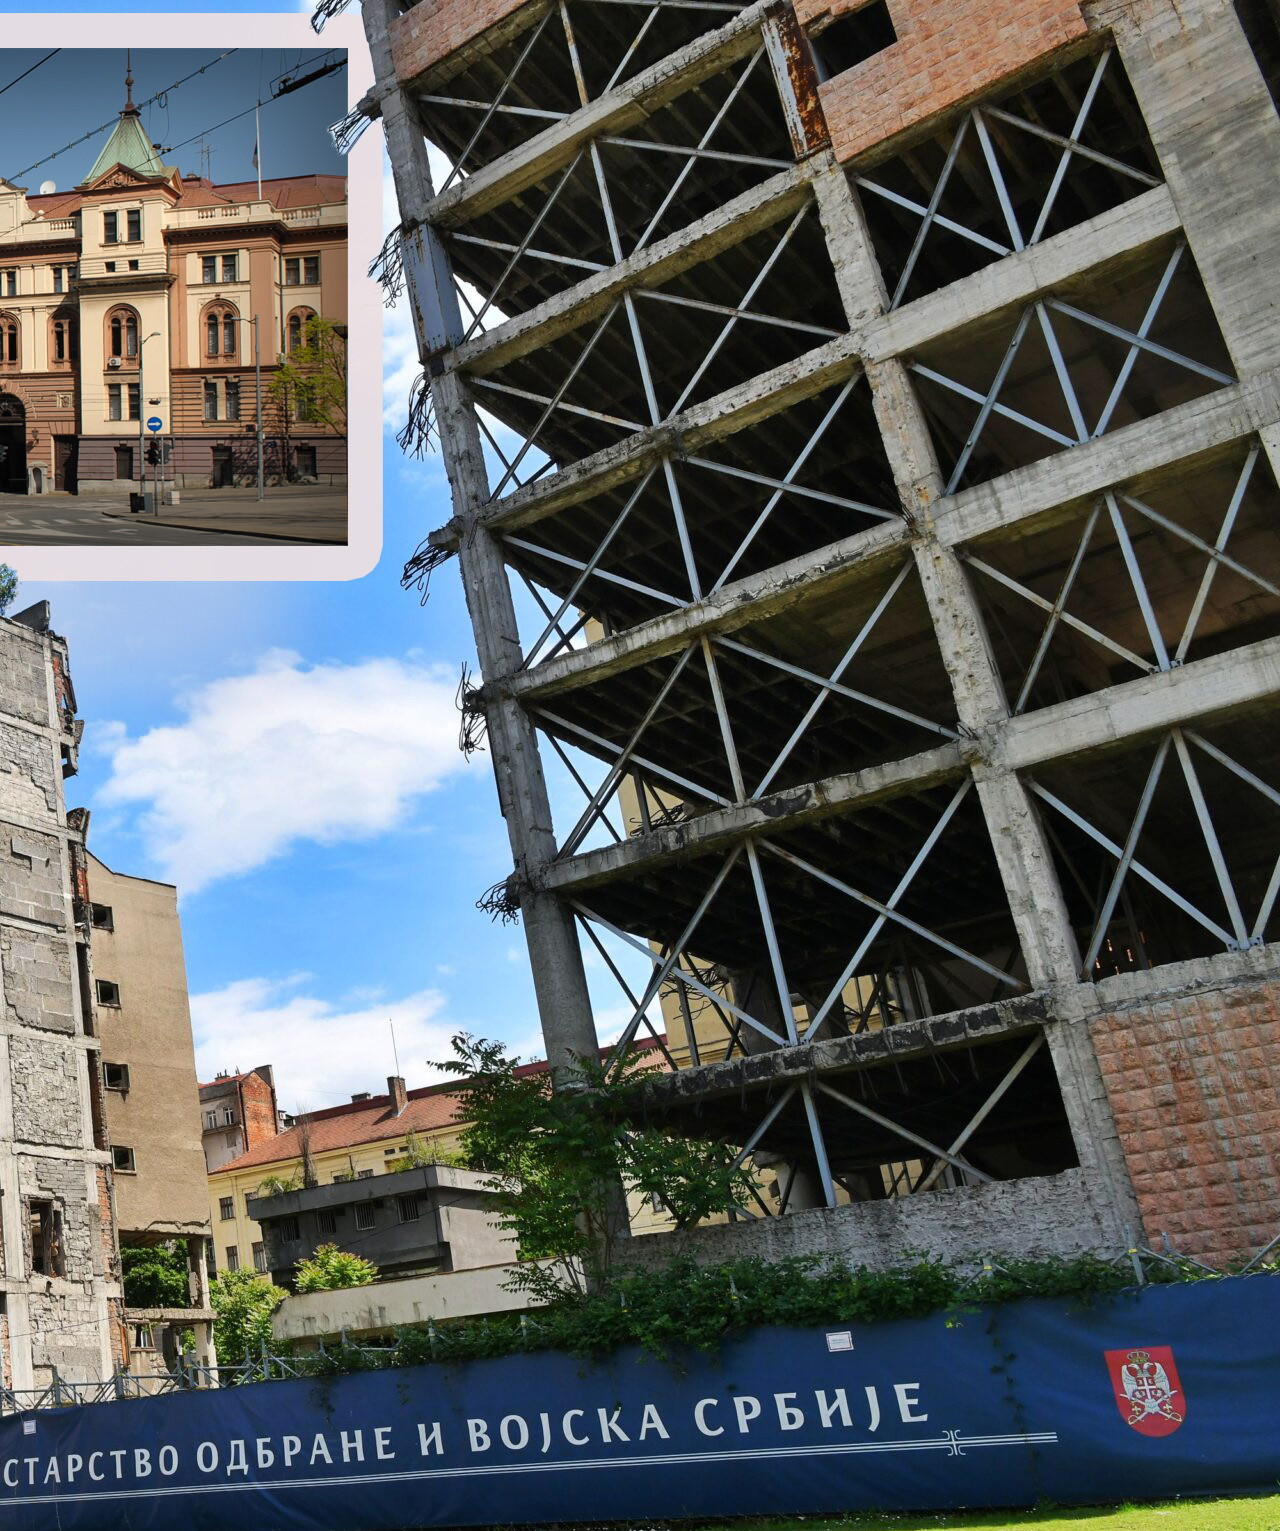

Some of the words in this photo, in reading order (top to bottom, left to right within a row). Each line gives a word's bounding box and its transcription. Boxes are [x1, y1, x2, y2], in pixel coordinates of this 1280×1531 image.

[196, 1426, 396, 1476] ОДБРАНЕ
[417, 1422, 444, 1456] И
[466, 1404, 670, 1453] ВОЈСКА
[694, 1382, 929, 1437] СРБИЈЕ
